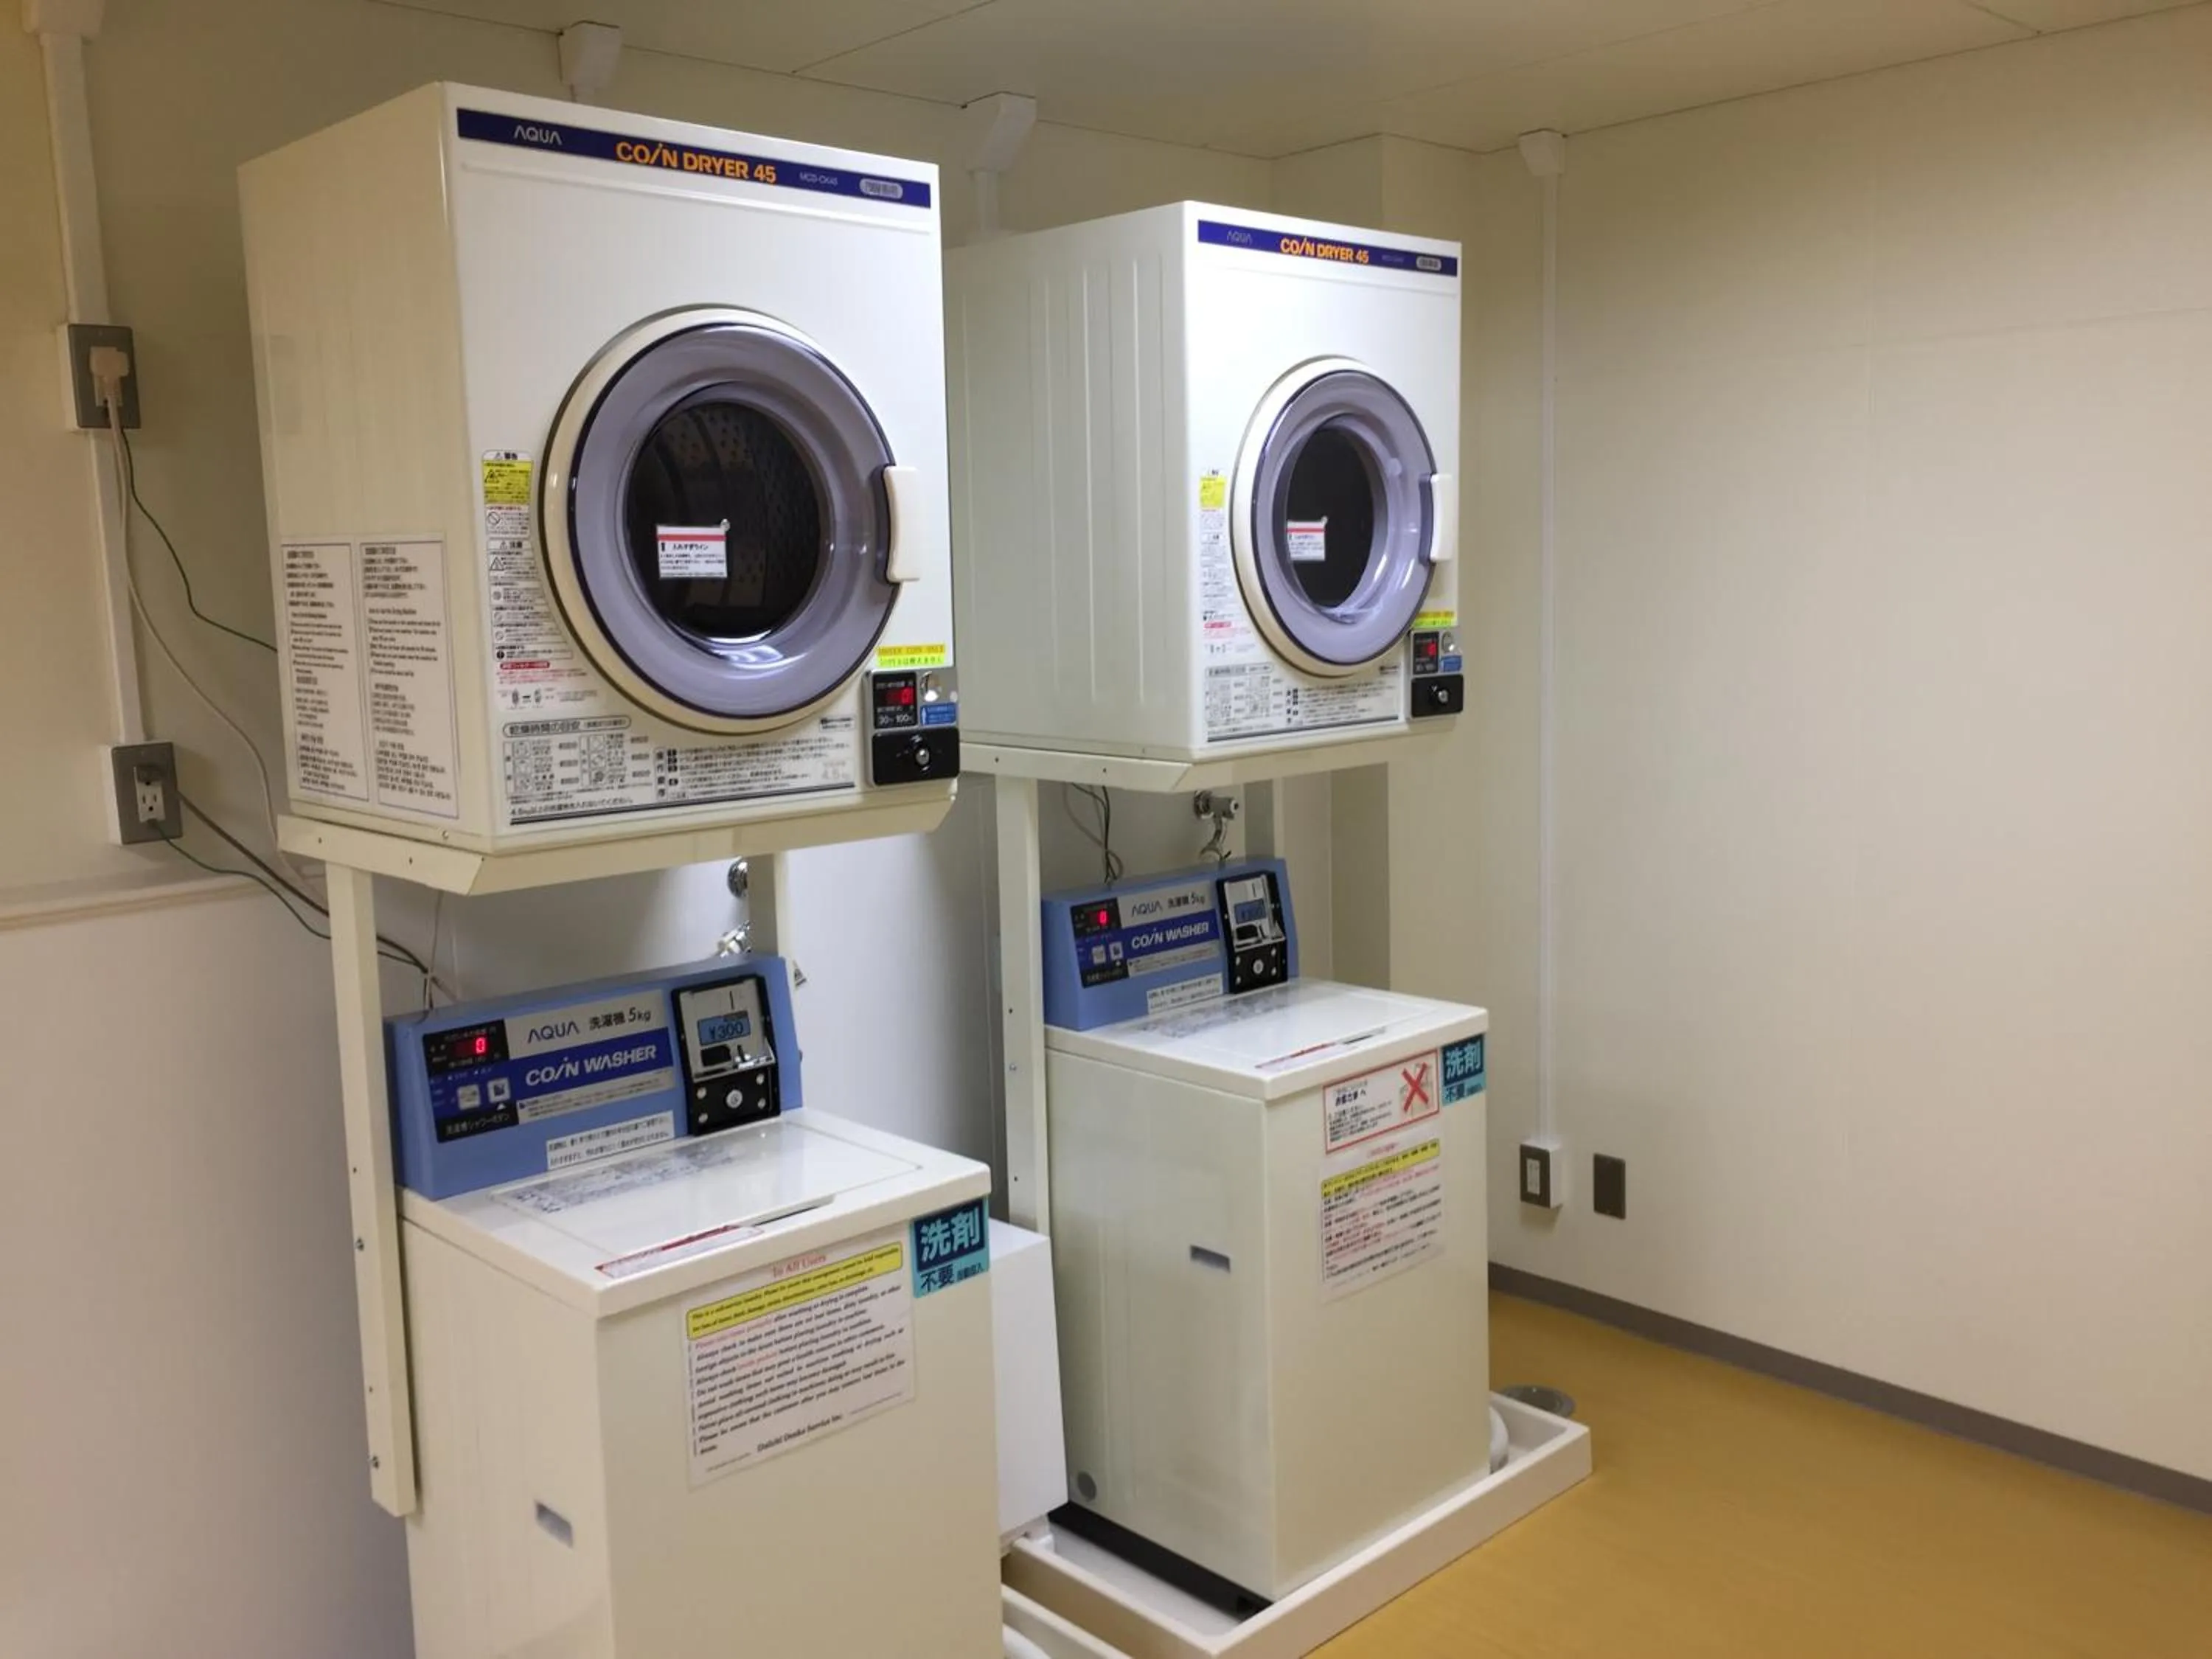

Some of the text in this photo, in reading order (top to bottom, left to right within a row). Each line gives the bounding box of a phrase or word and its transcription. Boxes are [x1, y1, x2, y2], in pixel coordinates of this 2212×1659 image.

[514, 125, 562, 145] AQUA
[684, 153, 748, 178] DRYER
[754, 164, 776, 184] 45
[1226, 231, 1252, 244] AQUA
[1317, 247, 1353, 262] DRYER
[1356, 250, 1369, 264] 45
[1132, 900, 1163, 917] AQUA
[1166, 921, 1209, 942] WASHER
[528, 1006, 651, 1043] AQUA 洗濯機 5kg
[475, 1037, 486, 1054] 0
[583, 1045, 657, 1074] WASHER
[1446, 1040, 1481, 1080] 洗剤
[920, 1207, 980, 1262] 洗剤
[920, 1263, 955, 1293] 不要
